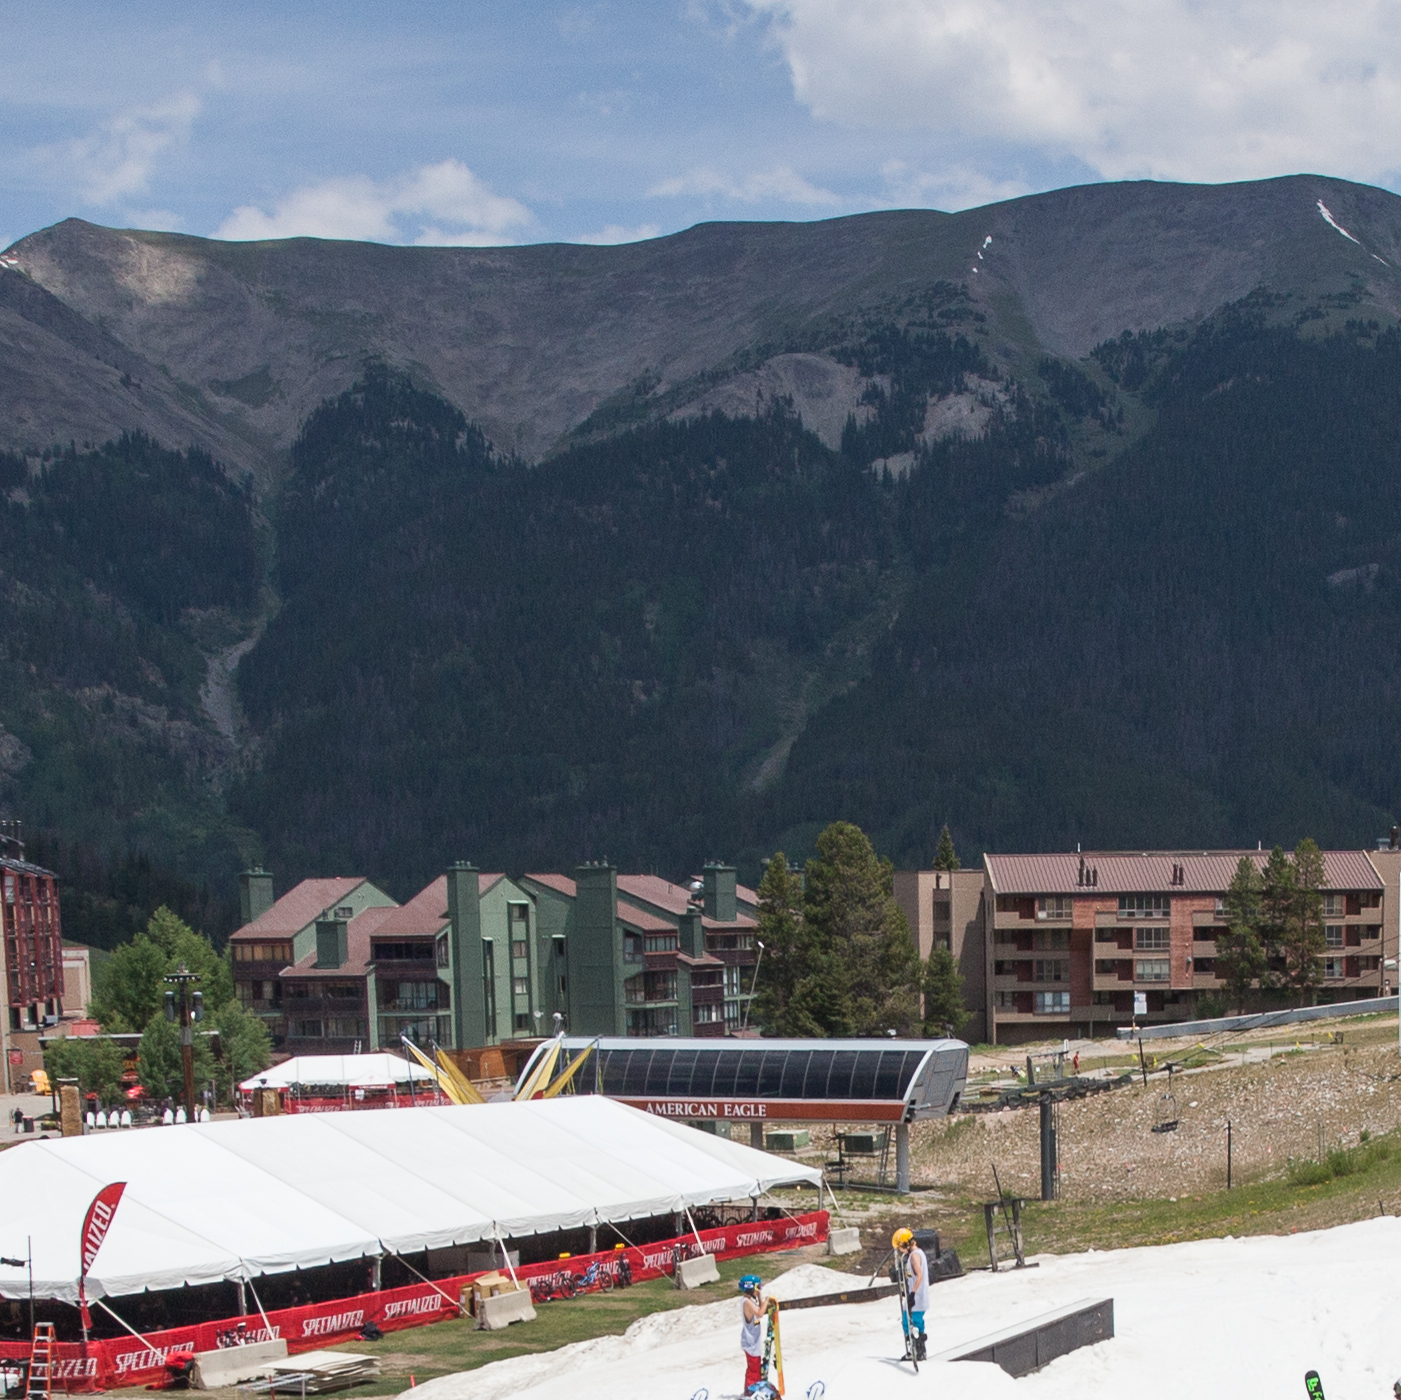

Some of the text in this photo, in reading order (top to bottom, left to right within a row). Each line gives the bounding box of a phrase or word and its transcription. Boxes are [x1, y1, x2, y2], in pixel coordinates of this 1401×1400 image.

[646, 1102, 767, 1117] AMERICAN EAGLE
[384, 1294, 442, 1321] SPECIALIZED
[302, 1310, 364, 1337] SPECIALIZED
